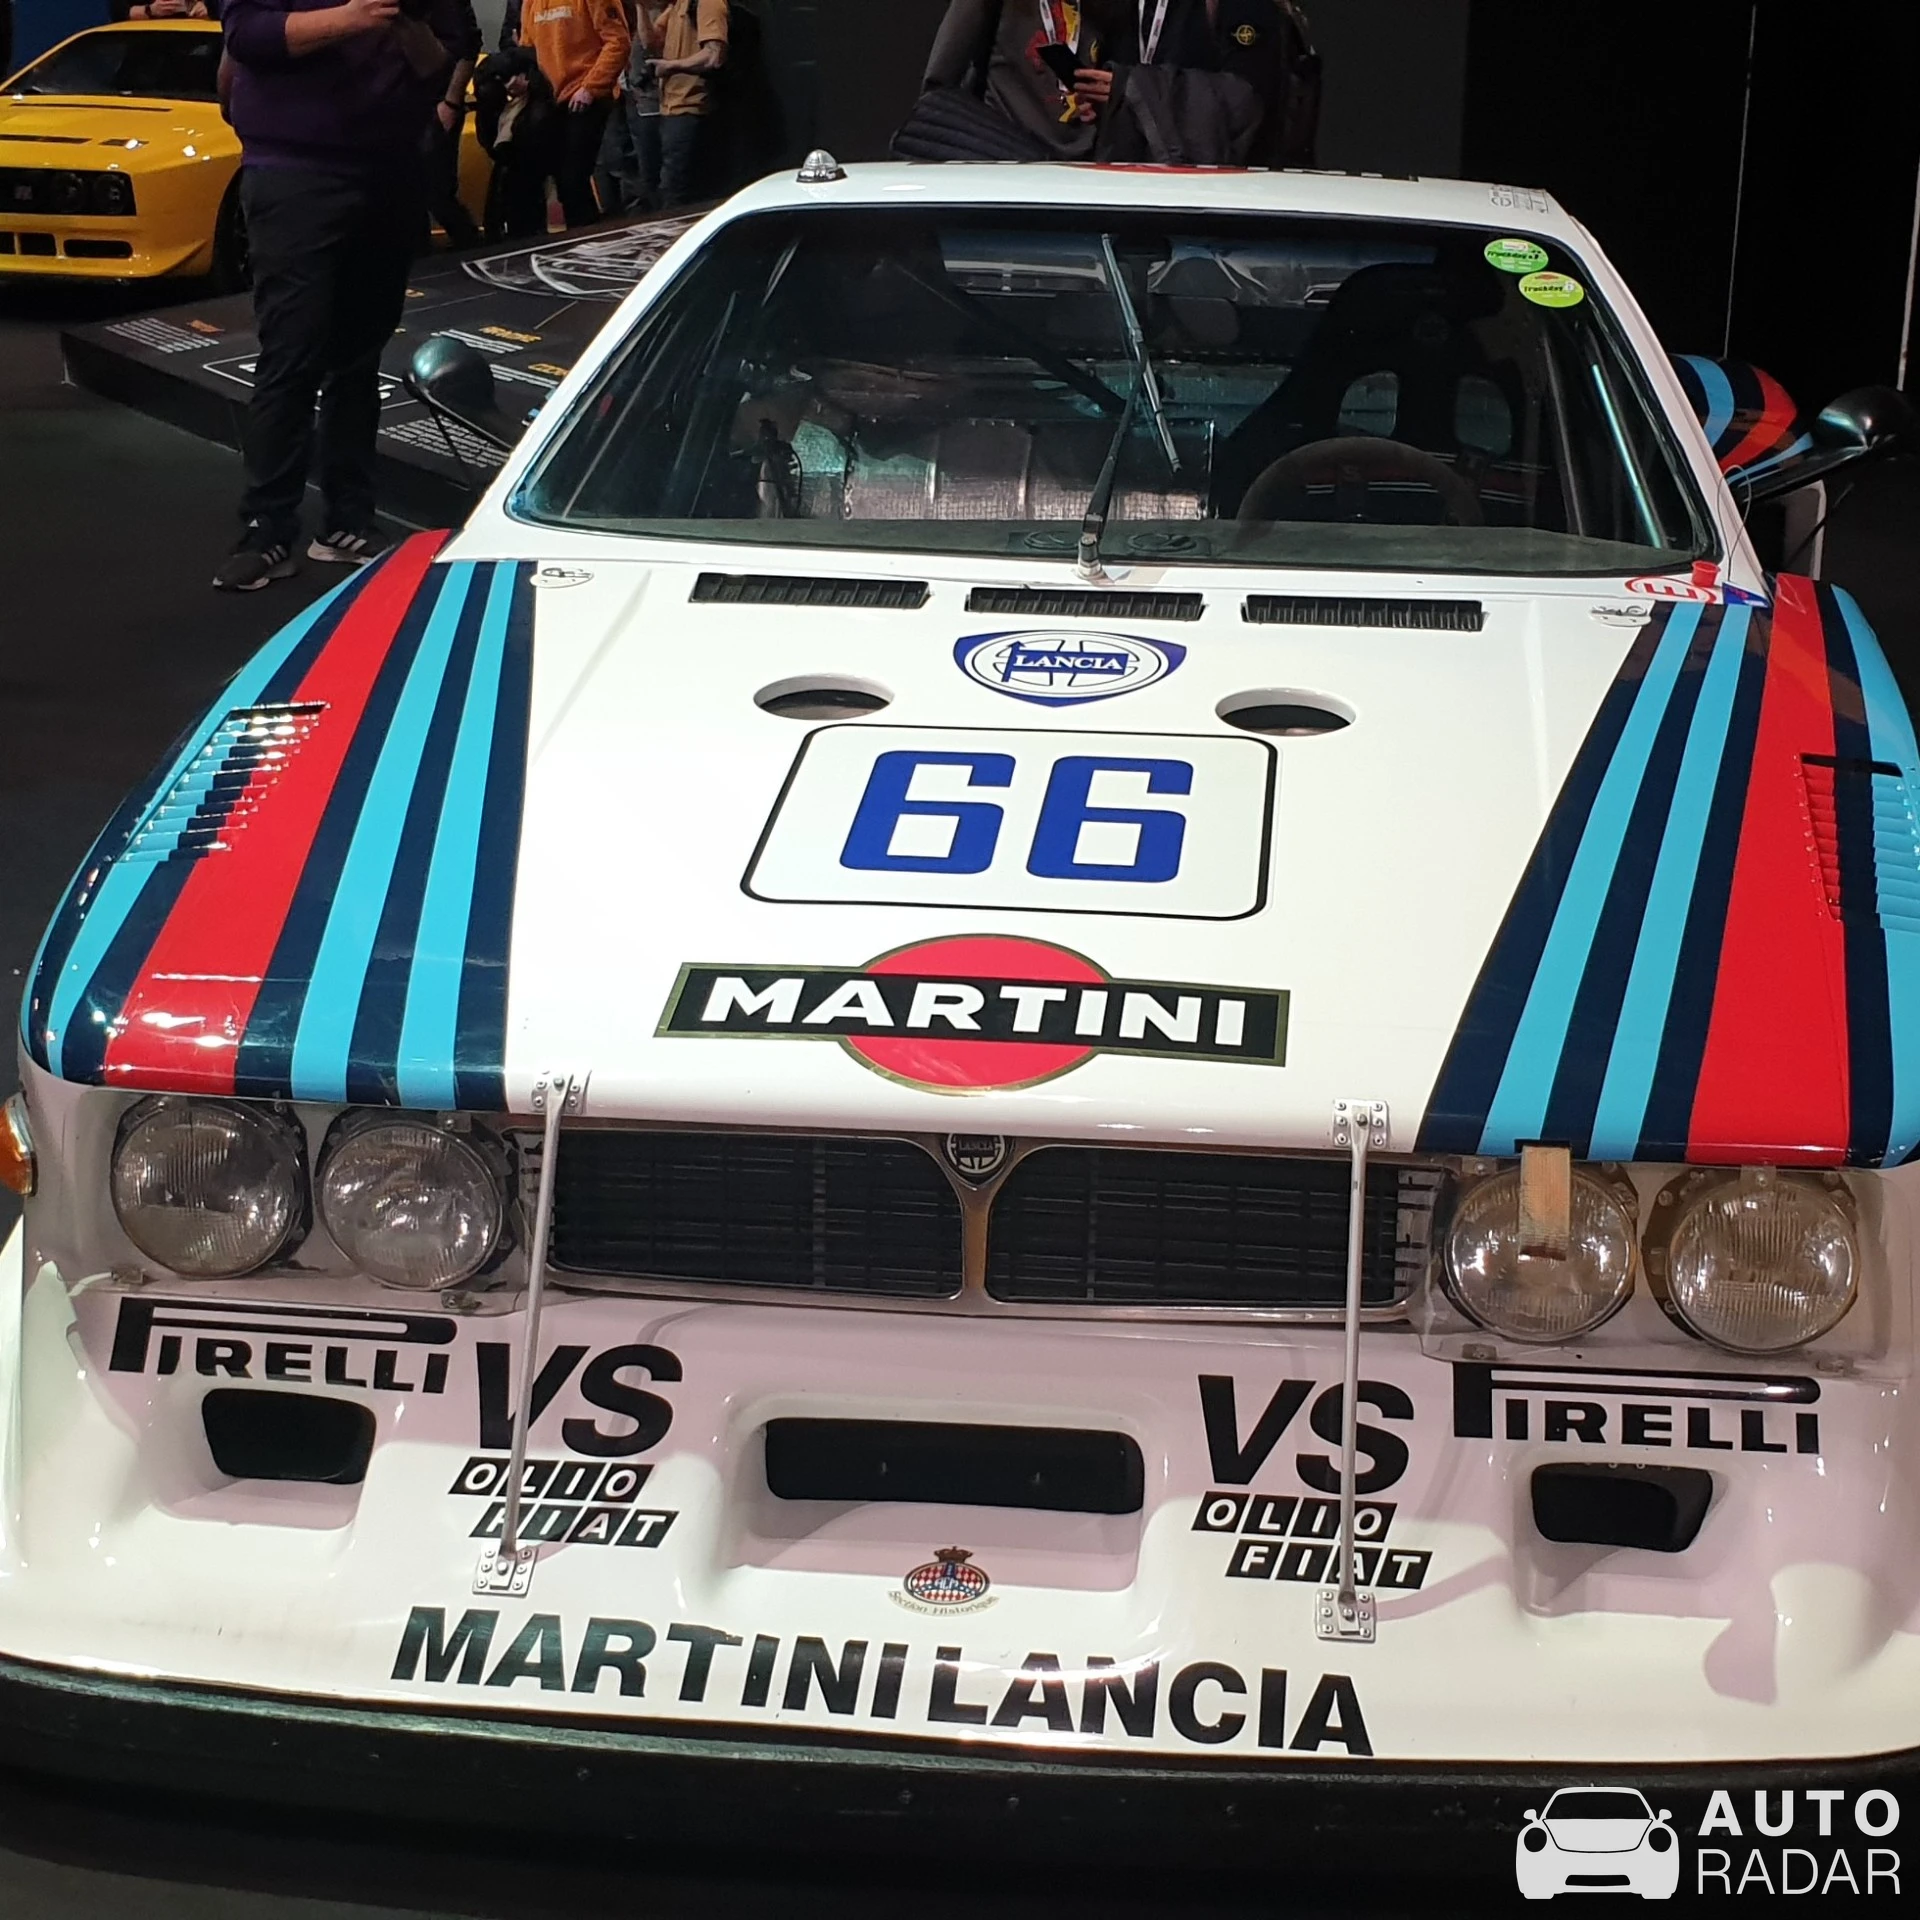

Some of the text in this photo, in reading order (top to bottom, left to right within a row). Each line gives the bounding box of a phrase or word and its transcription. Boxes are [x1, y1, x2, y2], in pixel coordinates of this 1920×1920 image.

[1012, 653, 1124, 673] LANCIA
[839, 749, 1194, 883] 66
[699, 976, 1246, 1047] MARTINI
[108, 1296, 458, 1394] PIRELLI
[475, 1341, 684, 1457] VS
[1198, 1374, 1415, 1495] VS
[1451, 1361, 1822, 1455] PIRELLI
[464, 1461, 637, 1498] OLIO
[1205, 1499, 1383, 1539] OLIO
[1237, 1546, 1422, 1587] FIAT
[391, 1606, 1375, 1757] MARTINI LANCIA
